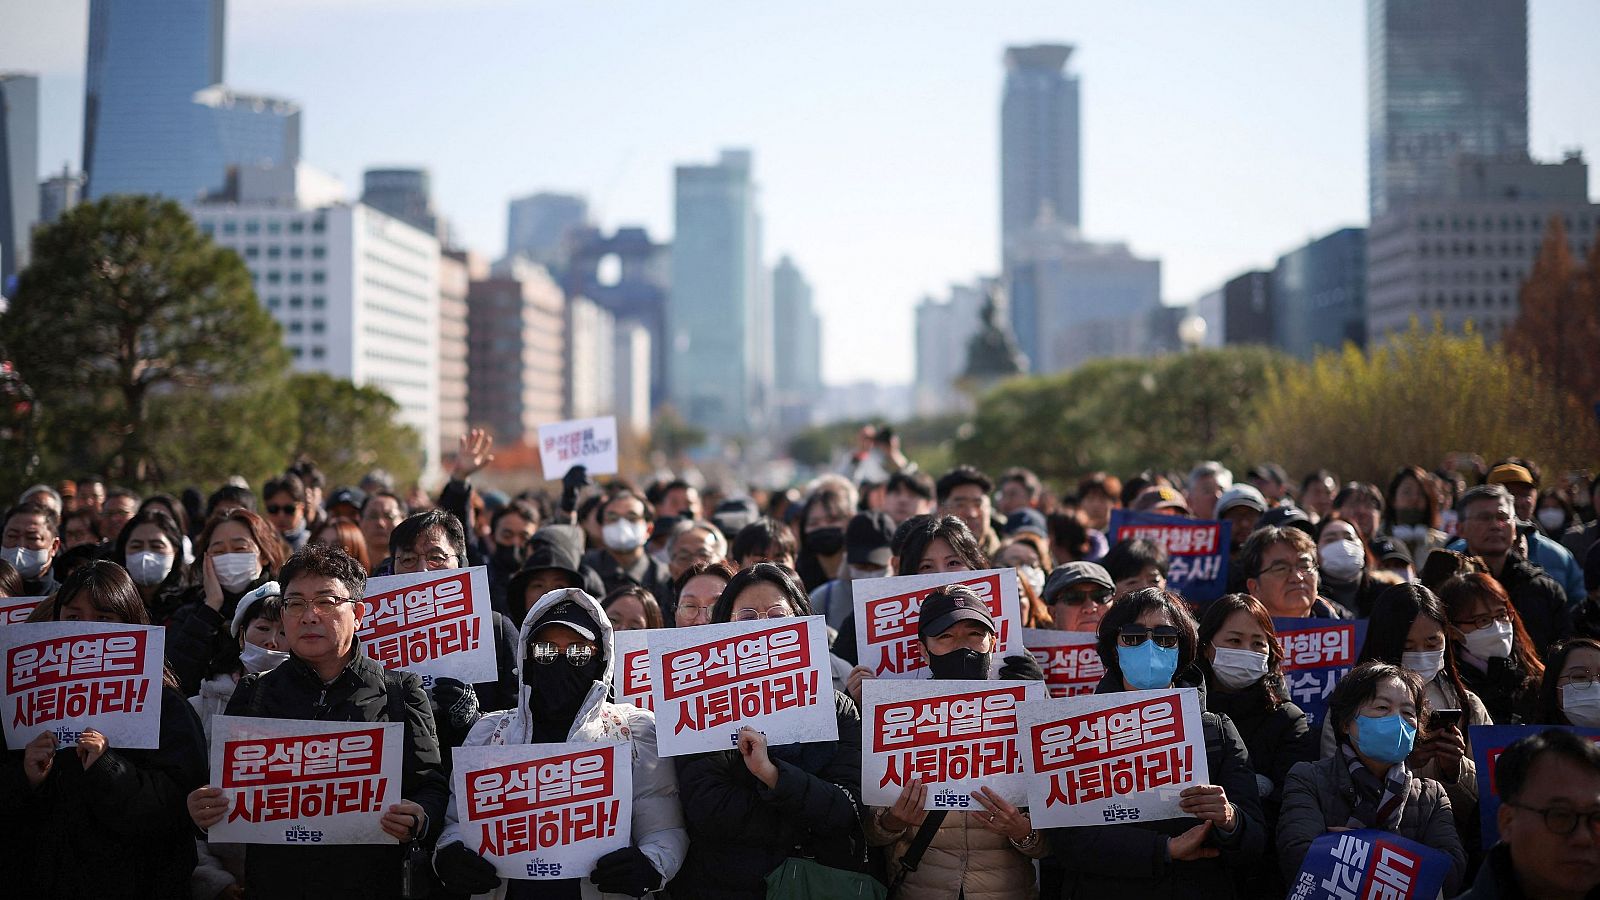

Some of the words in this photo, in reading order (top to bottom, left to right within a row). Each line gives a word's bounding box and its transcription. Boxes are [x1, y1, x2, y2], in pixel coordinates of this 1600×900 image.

[12, 636, 137, 686] 윤석열은
[368, 617, 481, 670] 퇴하라!
[671, 629, 801, 692] 윤석열은
[13, 678, 150, 731] 사퇴하라!
[675, 669, 818, 736] 사퇴하라!
[882, 693, 1016, 746] 윤석열은
[232, 735, 373, 782] 윤석열은
[1040, 701, 1175, 766] 윤석열은
[228, 777, 388, 824] 사퇴하라!
[474, 754, 605, 814] 윤석열은
[934, 794, 971, 808] 민주당
[1046, 744, 1193, 809] 사퇴하라!
[285, 829, 324, 842] 민주당
[478, 799, 620, 858] 사퇴하라!
[1102, 807, 1141, 822] 민주당
[526, 863, 563, 877] 민주당
